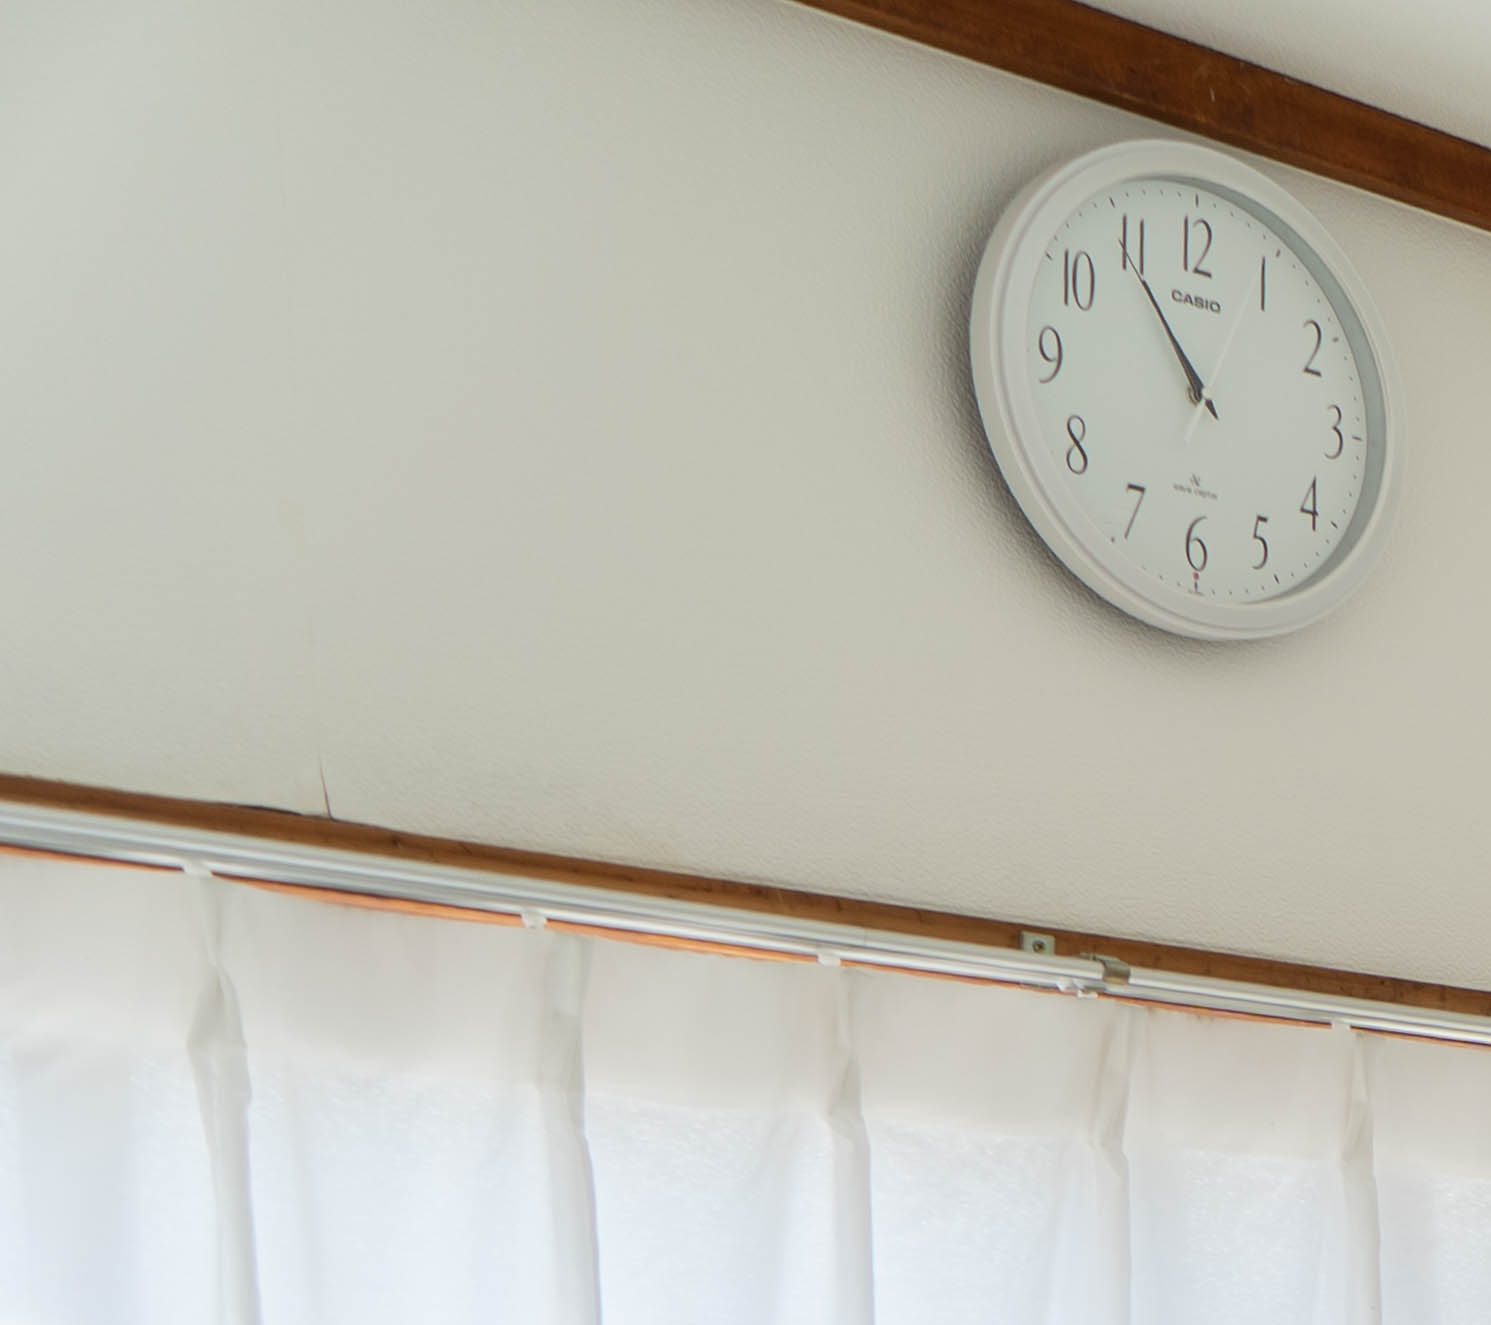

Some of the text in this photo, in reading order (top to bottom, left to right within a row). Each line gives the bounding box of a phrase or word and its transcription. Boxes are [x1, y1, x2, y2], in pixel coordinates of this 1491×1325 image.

[1120, 214, 1146, 276] 11
[1183, 214, 1213, 279] 12
[1063, 248, 1096, 312] 10
[1170, 288, 1222, 314] CASIO
[1259, 256, 1266, 312] 1
[1037, 325, 1064, 384] 9
[1302, 319, 1323, 378] 2
[1065, 415, 1088, 475] 8
[1324, 403, 1345, 460] 3
[1125, 482, 1147, 540] 7
[1299, 475, 1319, 531] 4
[1184, 516, 1208, 572] 6
[1252, 514, 1269, 570] 5
